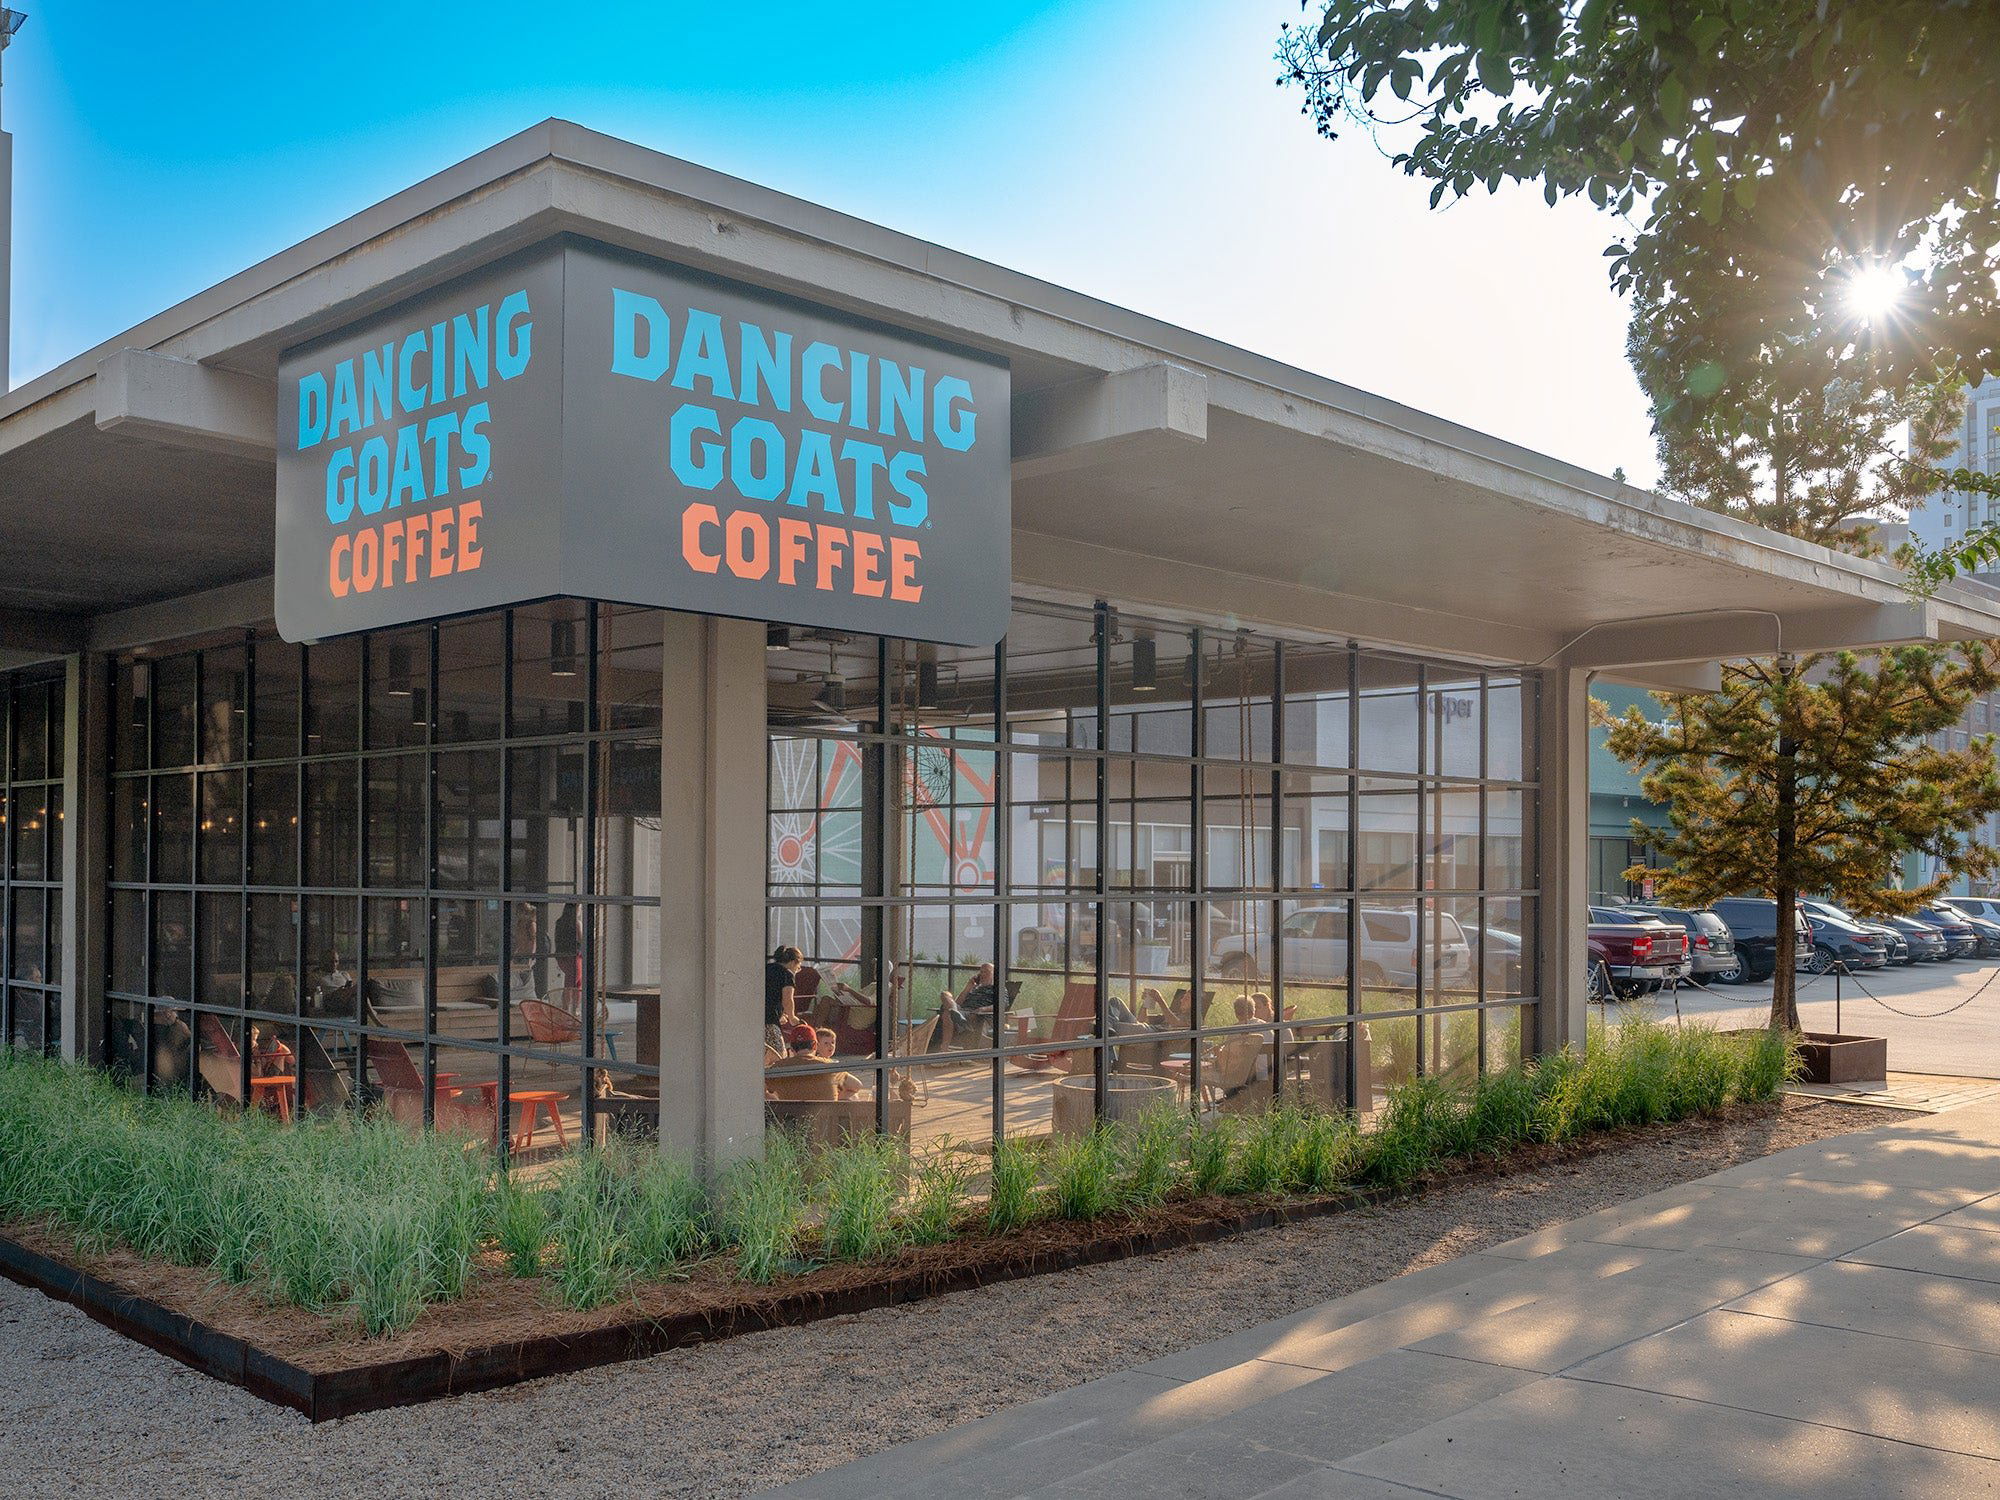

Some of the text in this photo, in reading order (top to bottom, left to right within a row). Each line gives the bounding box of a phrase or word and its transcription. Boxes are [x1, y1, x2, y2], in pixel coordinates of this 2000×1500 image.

[297, 289, 534, 451] DANCING
[611, 287, 978, 453] DANCING
[325, 401, 492, 525] GOATS
[669, 402, 929, 529] GOATS
[329, 499, 485, 599] COFFEE
[681, 502, 924, 604] COFFEE
